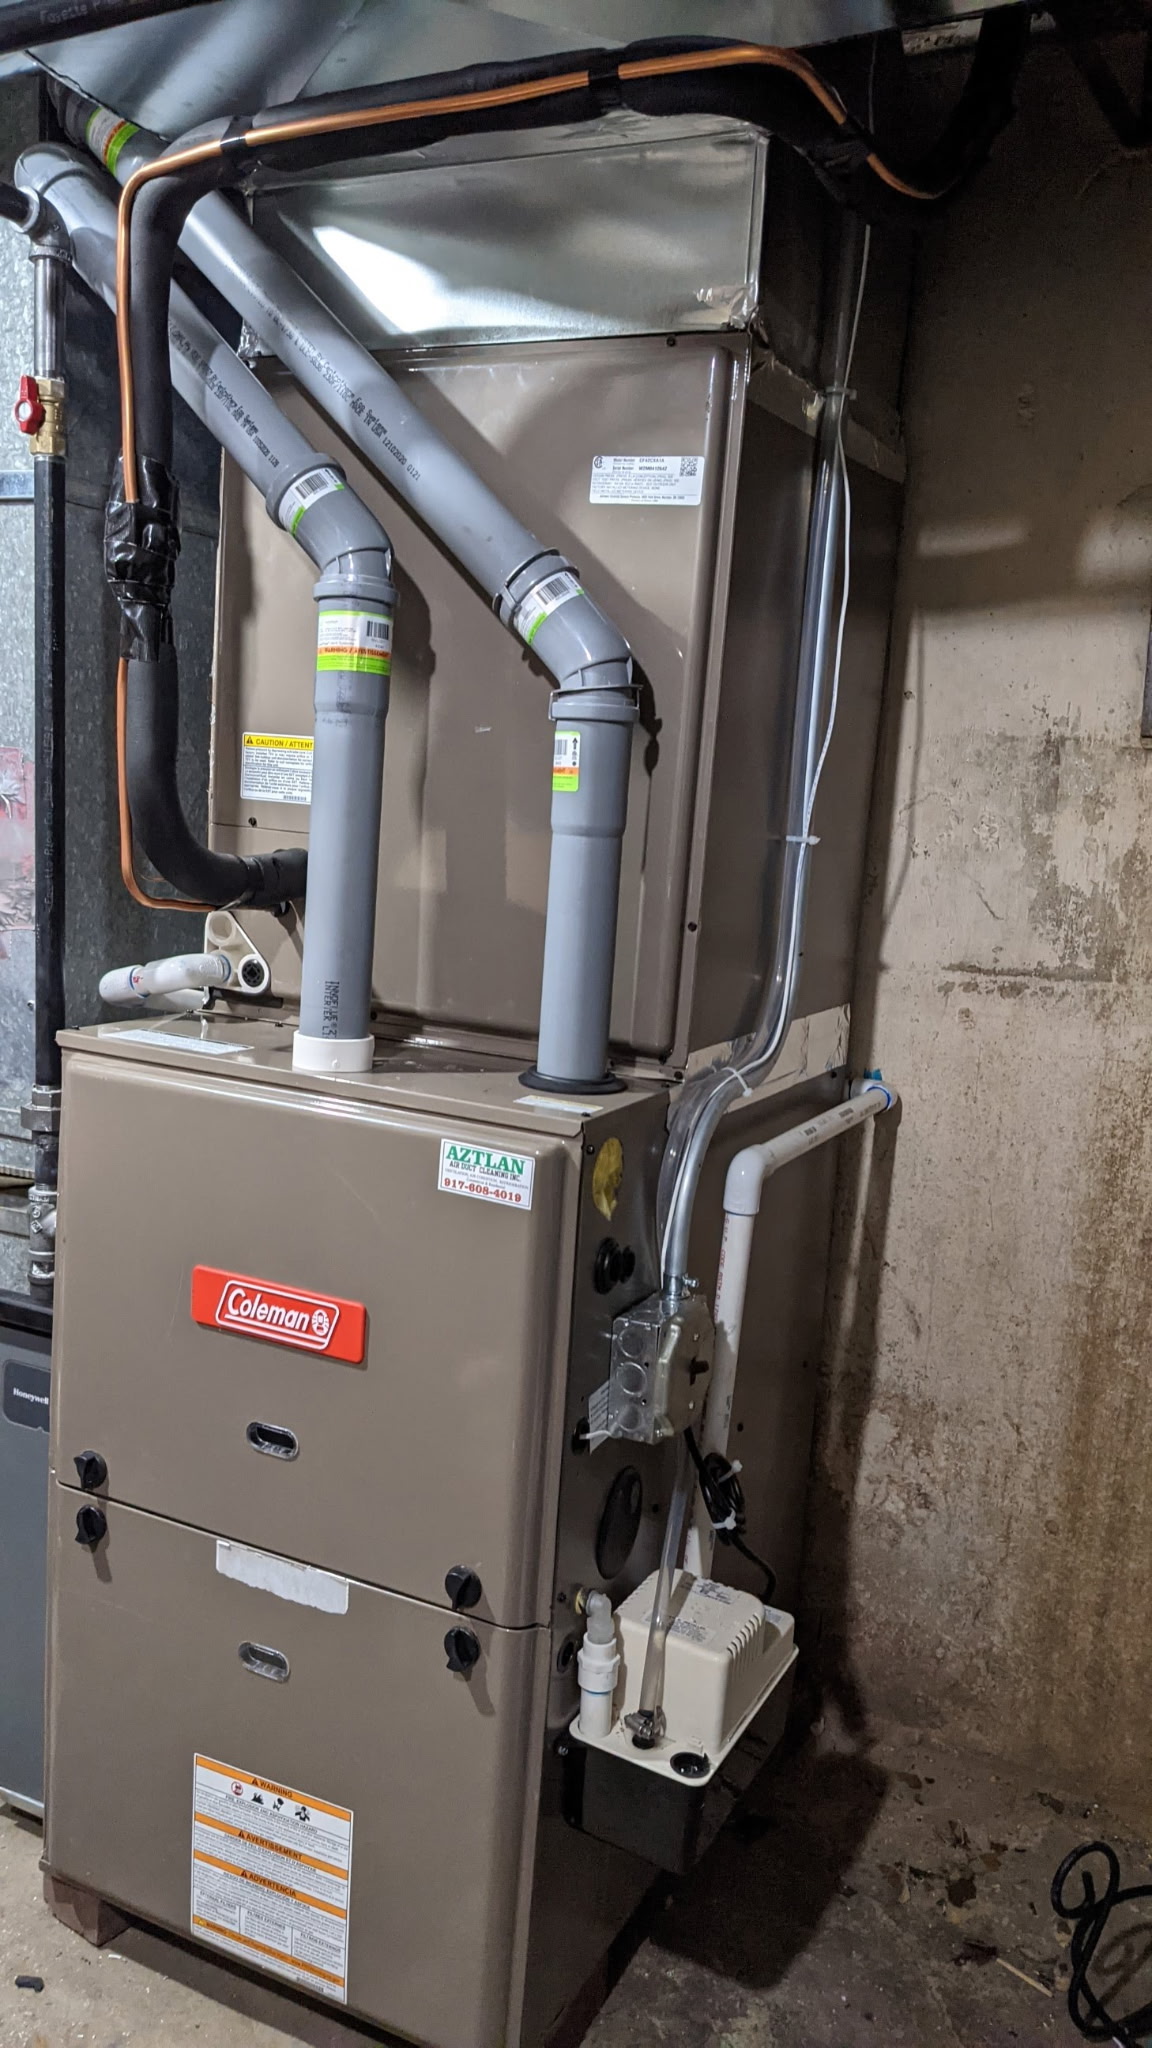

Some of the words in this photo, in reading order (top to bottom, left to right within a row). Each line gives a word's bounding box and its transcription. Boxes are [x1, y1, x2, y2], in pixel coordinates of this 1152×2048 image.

[382, 436, 407, 465] 12102020
[406, 464, 421, 481] 0121
[255, 738, 284, 747] CAUTION
[446, 1145, 525, 1174] AZTLAN
[461, 1163, 476, 1172] DUCT
[479, 1167, 508, 1179] CLEANING
[510, 1174, 521, 1182] INC.
[444, 1178, 522, 1202] 917-608-4019
[227, 1288, 310, 1332] Coleman
[13, 1387, 49, 1405] Honeywell
[260, 1780, 293, 1798] WARNING
[246, 1833, 302, 1860] AVERTISSEMENT
[249, 1873, 296, 1897] ADVERTENCIA
